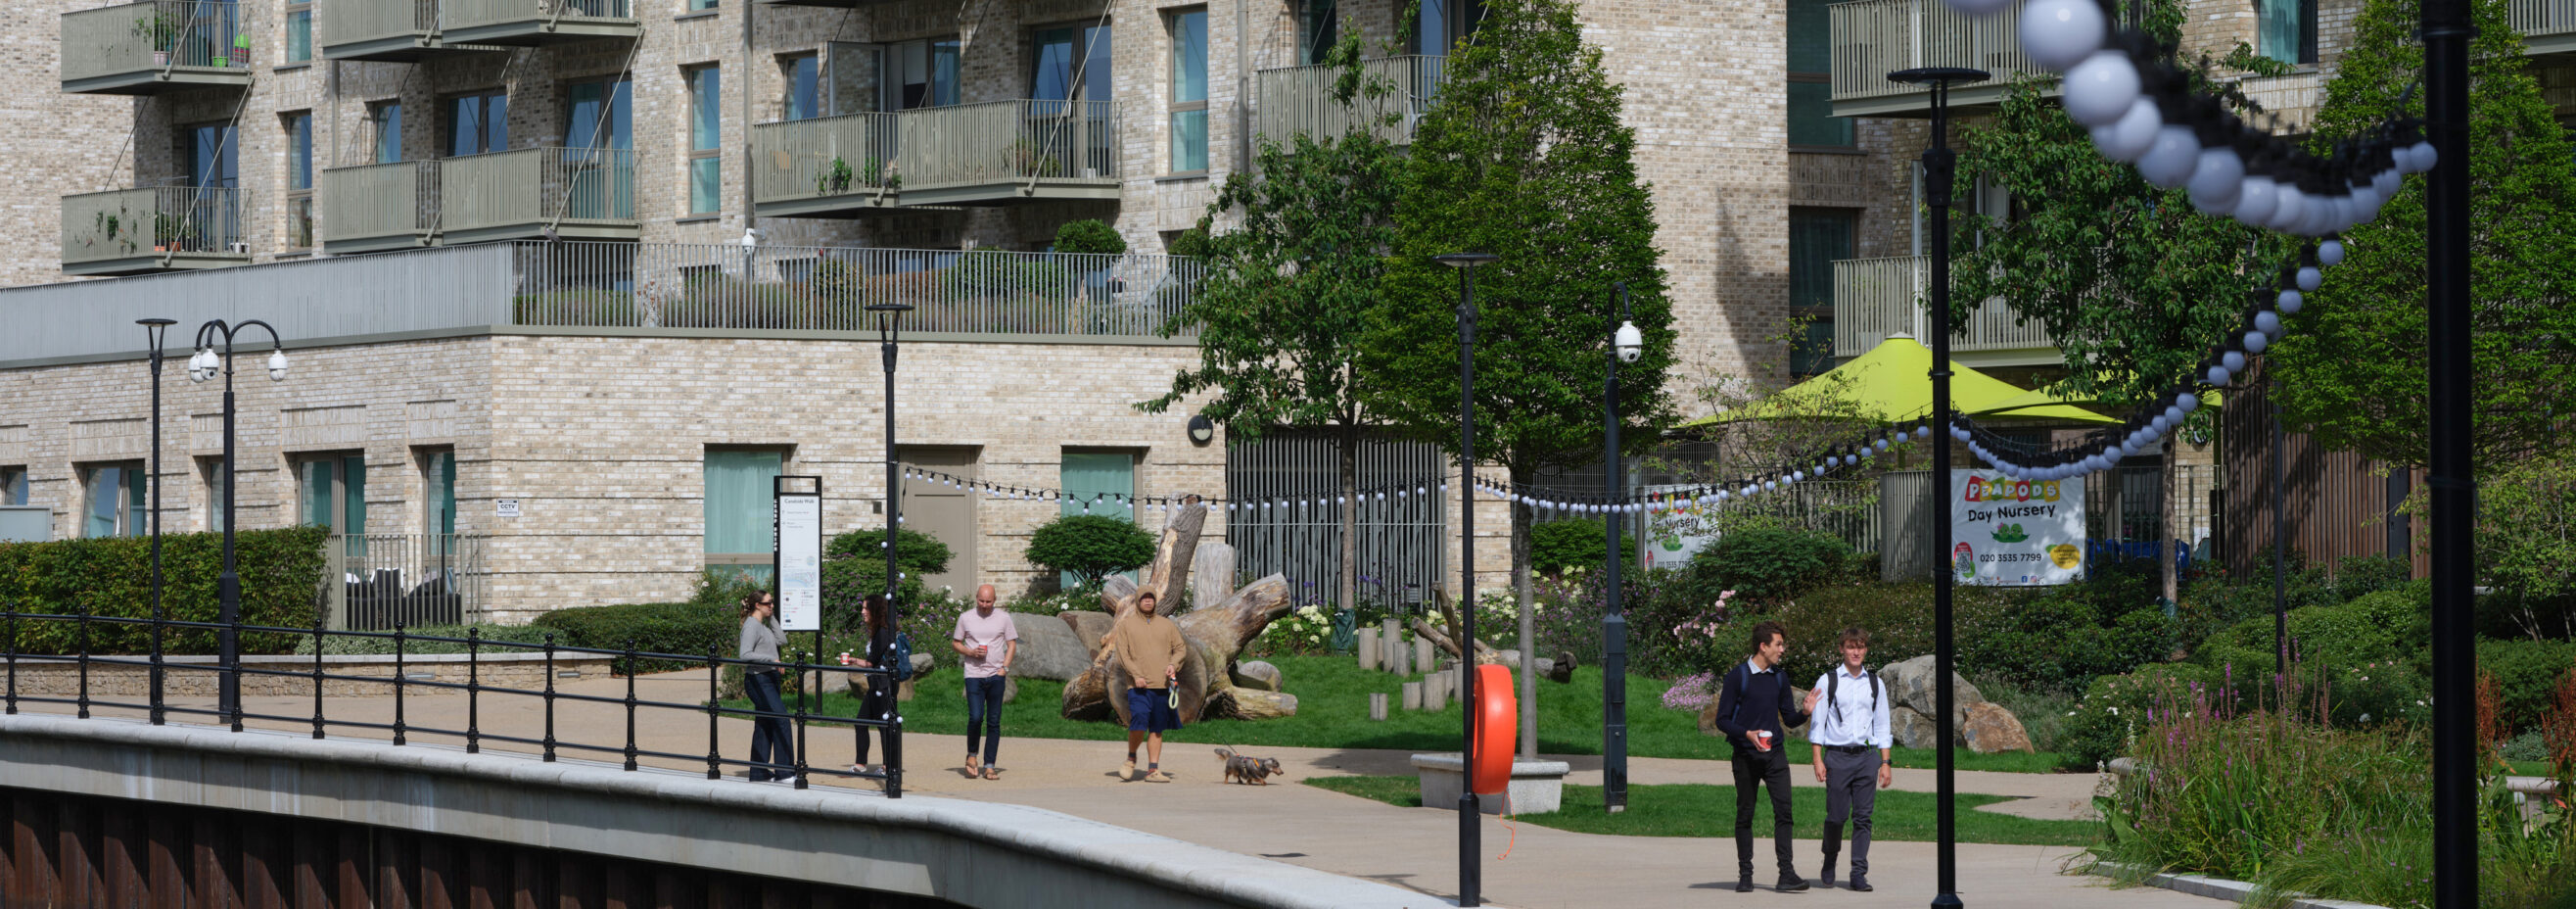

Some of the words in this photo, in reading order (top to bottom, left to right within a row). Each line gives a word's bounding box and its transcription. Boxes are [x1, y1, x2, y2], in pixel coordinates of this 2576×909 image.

[1968, 481, 2057, 500] PEAPODS
[1968, 509, 1992, 523] Day
[1997, 504, 2056, 519] Nursery
[1980, 553, 1995, 563] 020
[1997, 553, 2018, 562] 3535
[2020, 552, 2042, 562] 7799
